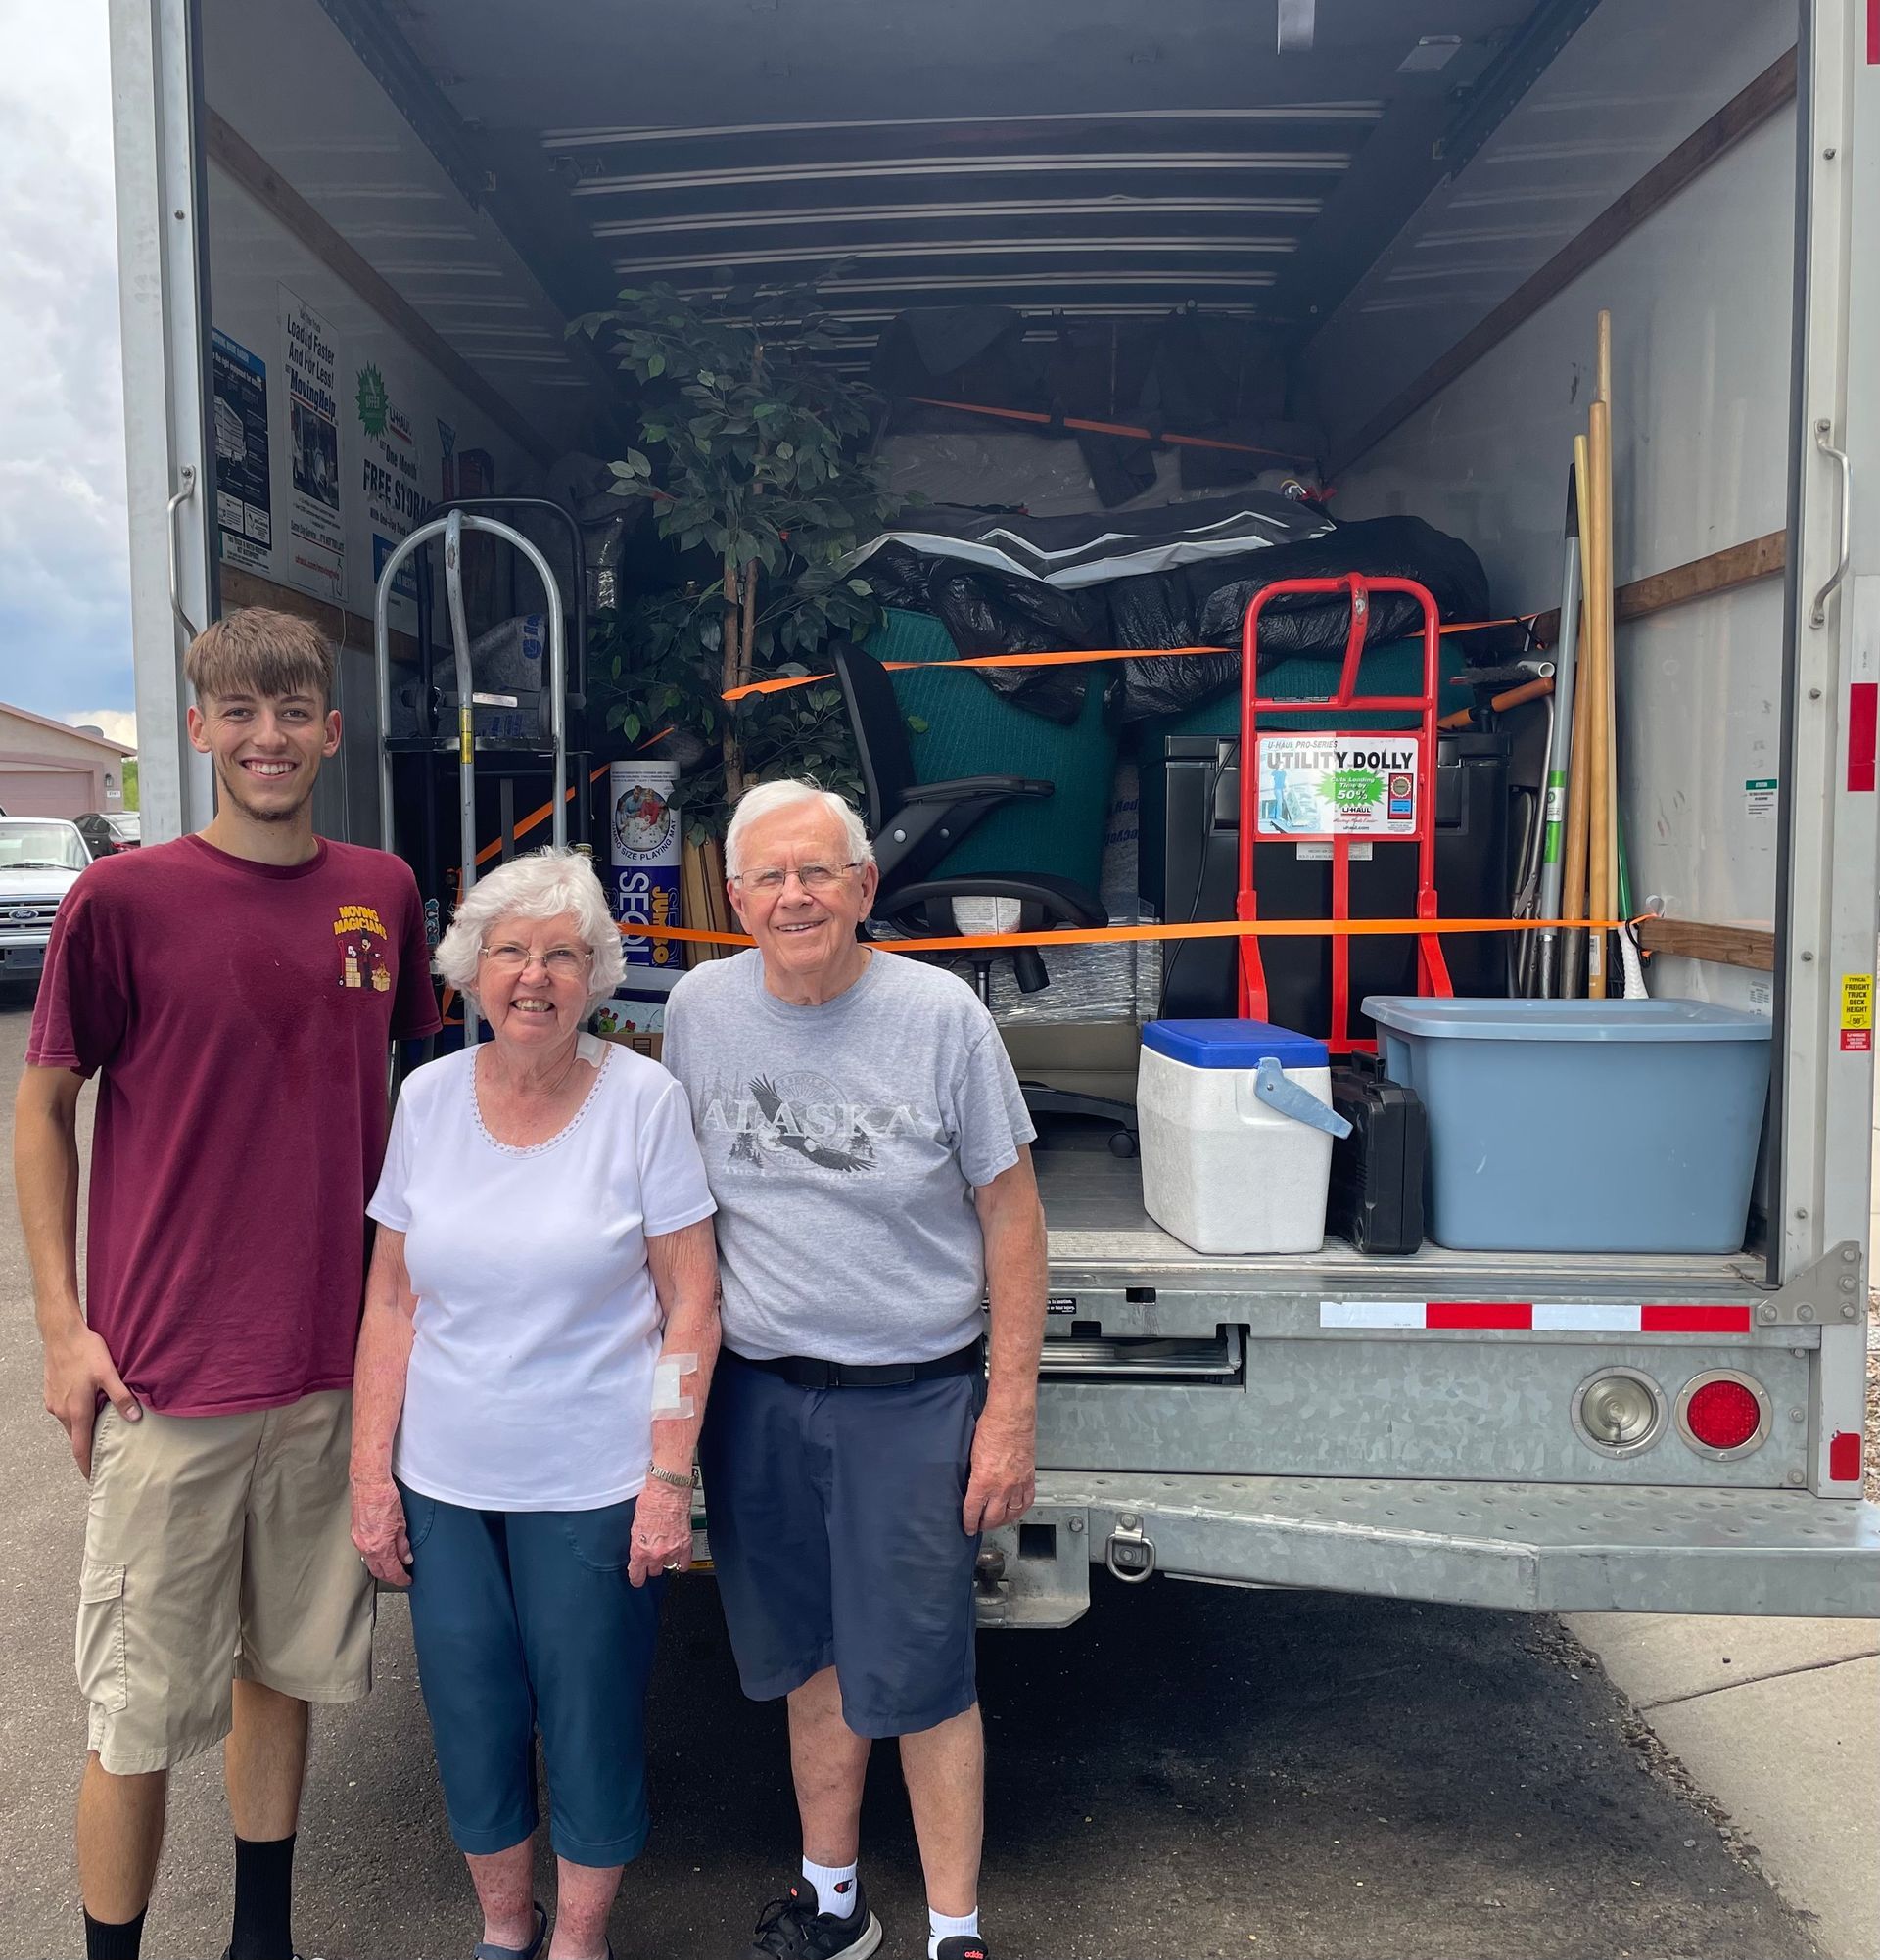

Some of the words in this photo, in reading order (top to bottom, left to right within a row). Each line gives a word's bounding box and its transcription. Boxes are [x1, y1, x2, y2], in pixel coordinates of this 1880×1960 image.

[287, 313, 312, 350] Loaded
[313, 335, 335, 366] Faster
[288, 341, 304, 368] And
[304, 351, 315, 376] For
[316, 359, 334, 390] Less!
[290, 368, 336, 422] MovingHelp
[386, 444, 398, 468] One
[399, 453, 417, 480] Month
[362, 458, 392, 507] FREE
[1266, 751, 1348, 770] UTILITY
[1353, 751, 1414, 770] DOLLY
[1267, 740, 1293, 749] U-HAUL
[1295, 740, 1338, 749] PRO-SERIES
[1337, 789, 1368, 800] 50%
[612, 820, 622, 849] JUMBO
[621, 847, 638, 861] SIZE
[639, 839, 673, 861] PLAYING
[15, 910, 32, 919] Ford
[333, 917, 388, 941] MAGICIANS
[338, 906, 380, 922] MOVING
[702, 1097, 925, 1138] ALASKA
